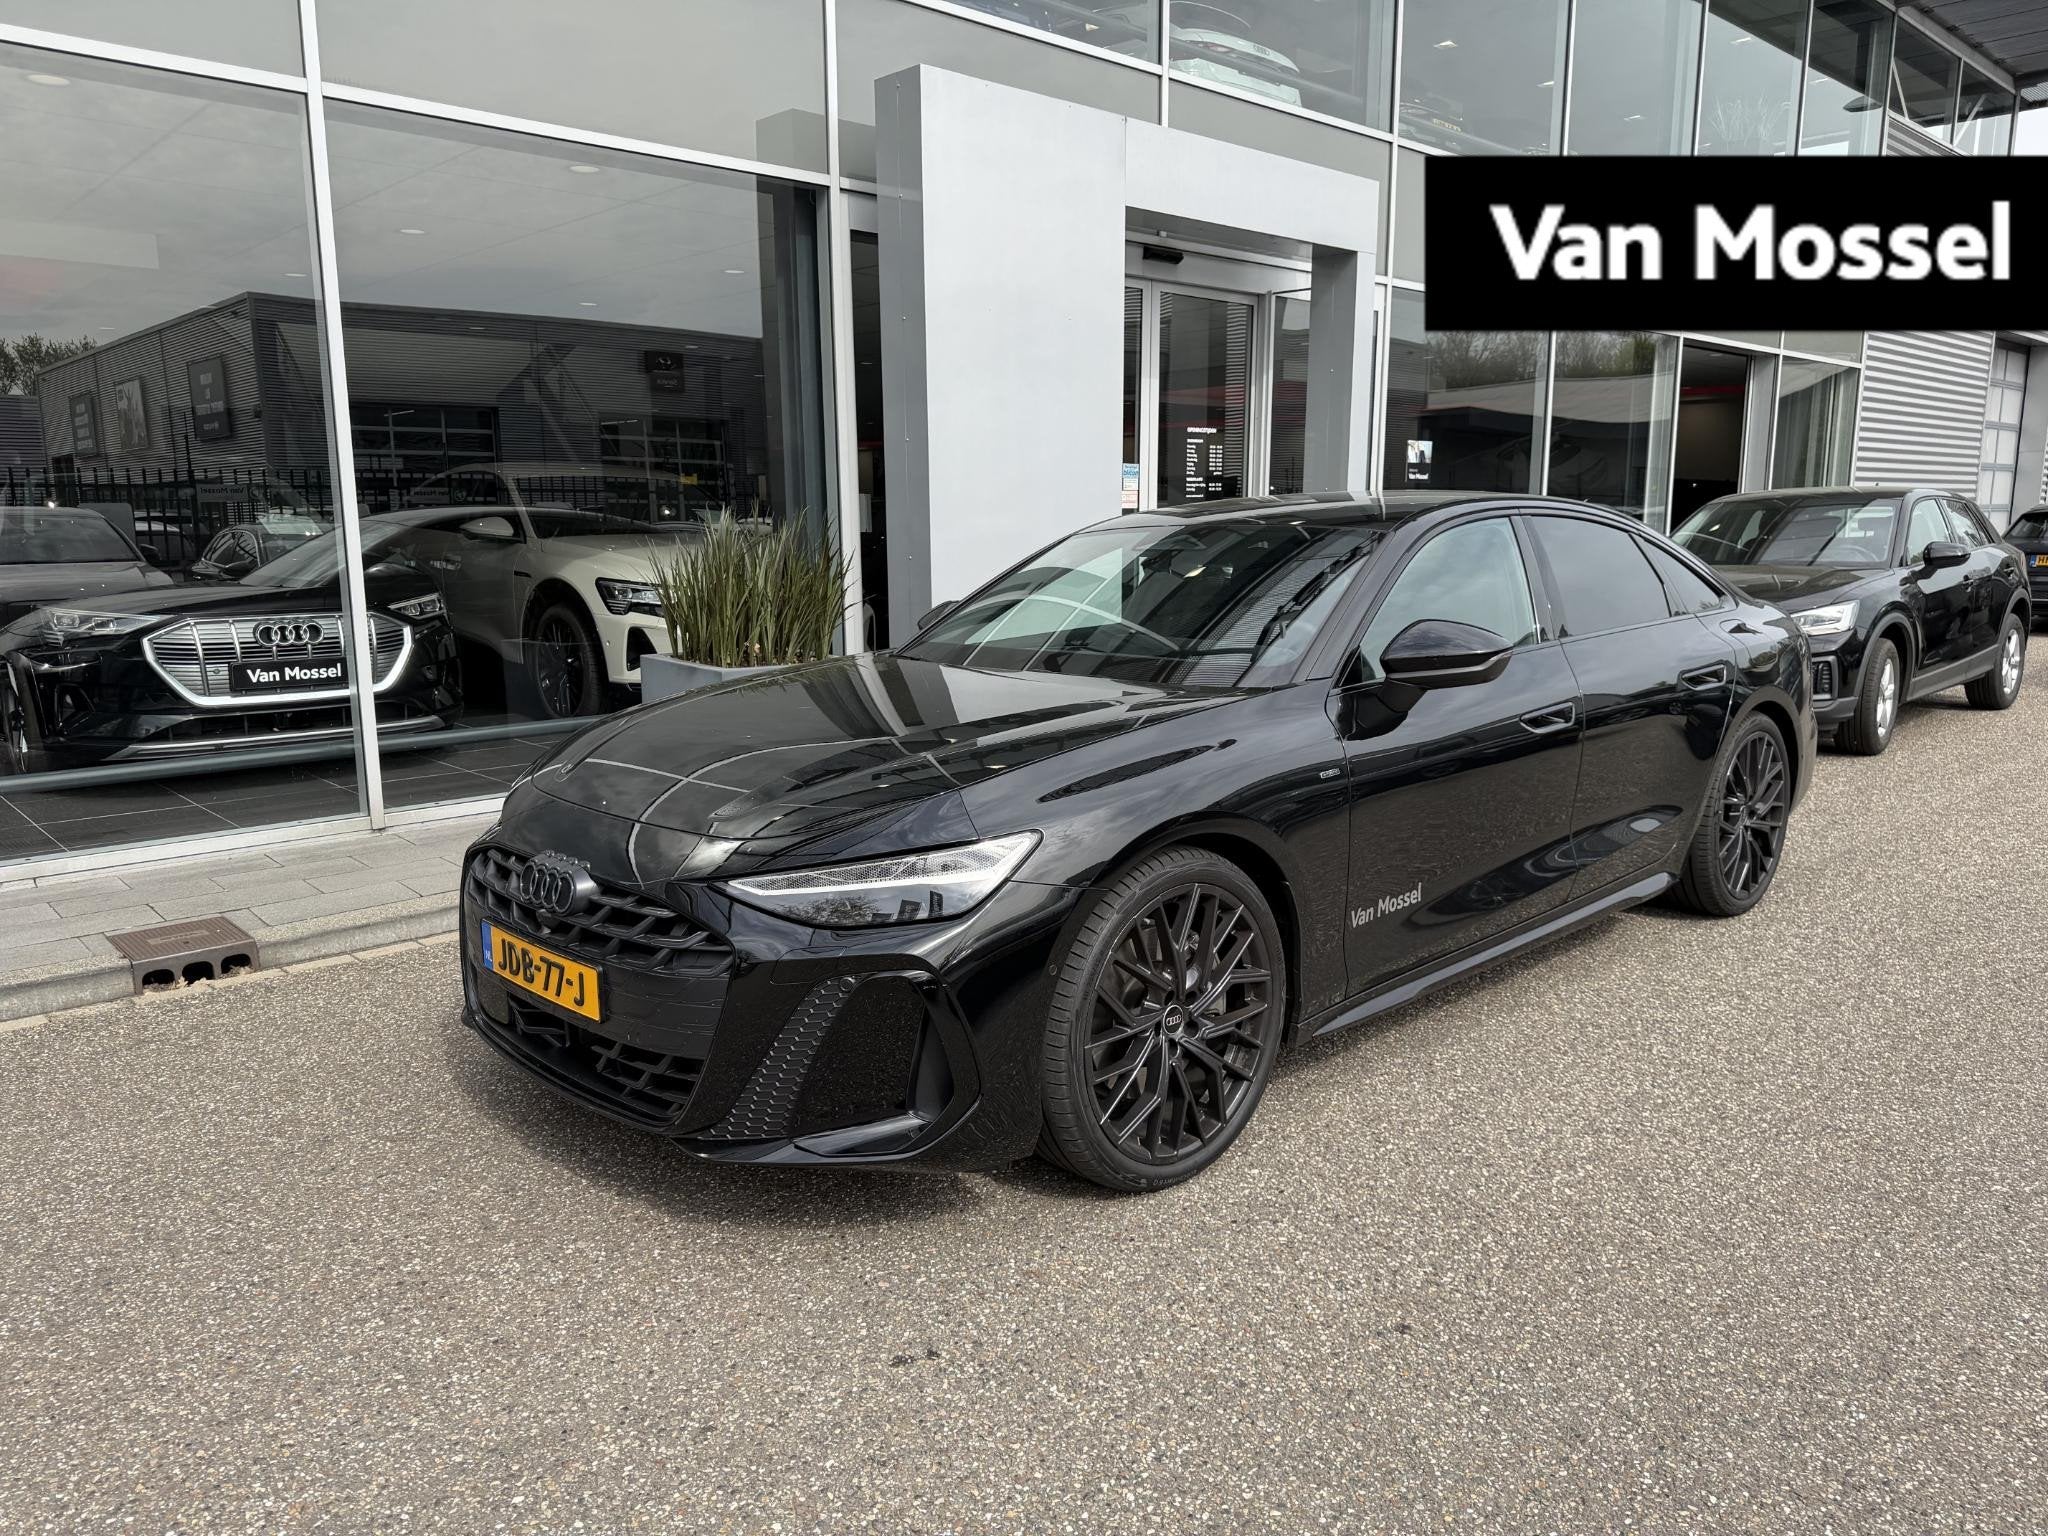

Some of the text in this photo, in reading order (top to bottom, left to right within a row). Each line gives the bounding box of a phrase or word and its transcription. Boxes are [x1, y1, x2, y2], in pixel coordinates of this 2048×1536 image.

[246, 663, 342, 683] Van Mossel
[1351, 882, 1422, 929] Van Mossel
[498, 938, 585, 1007] JDB-77-J
